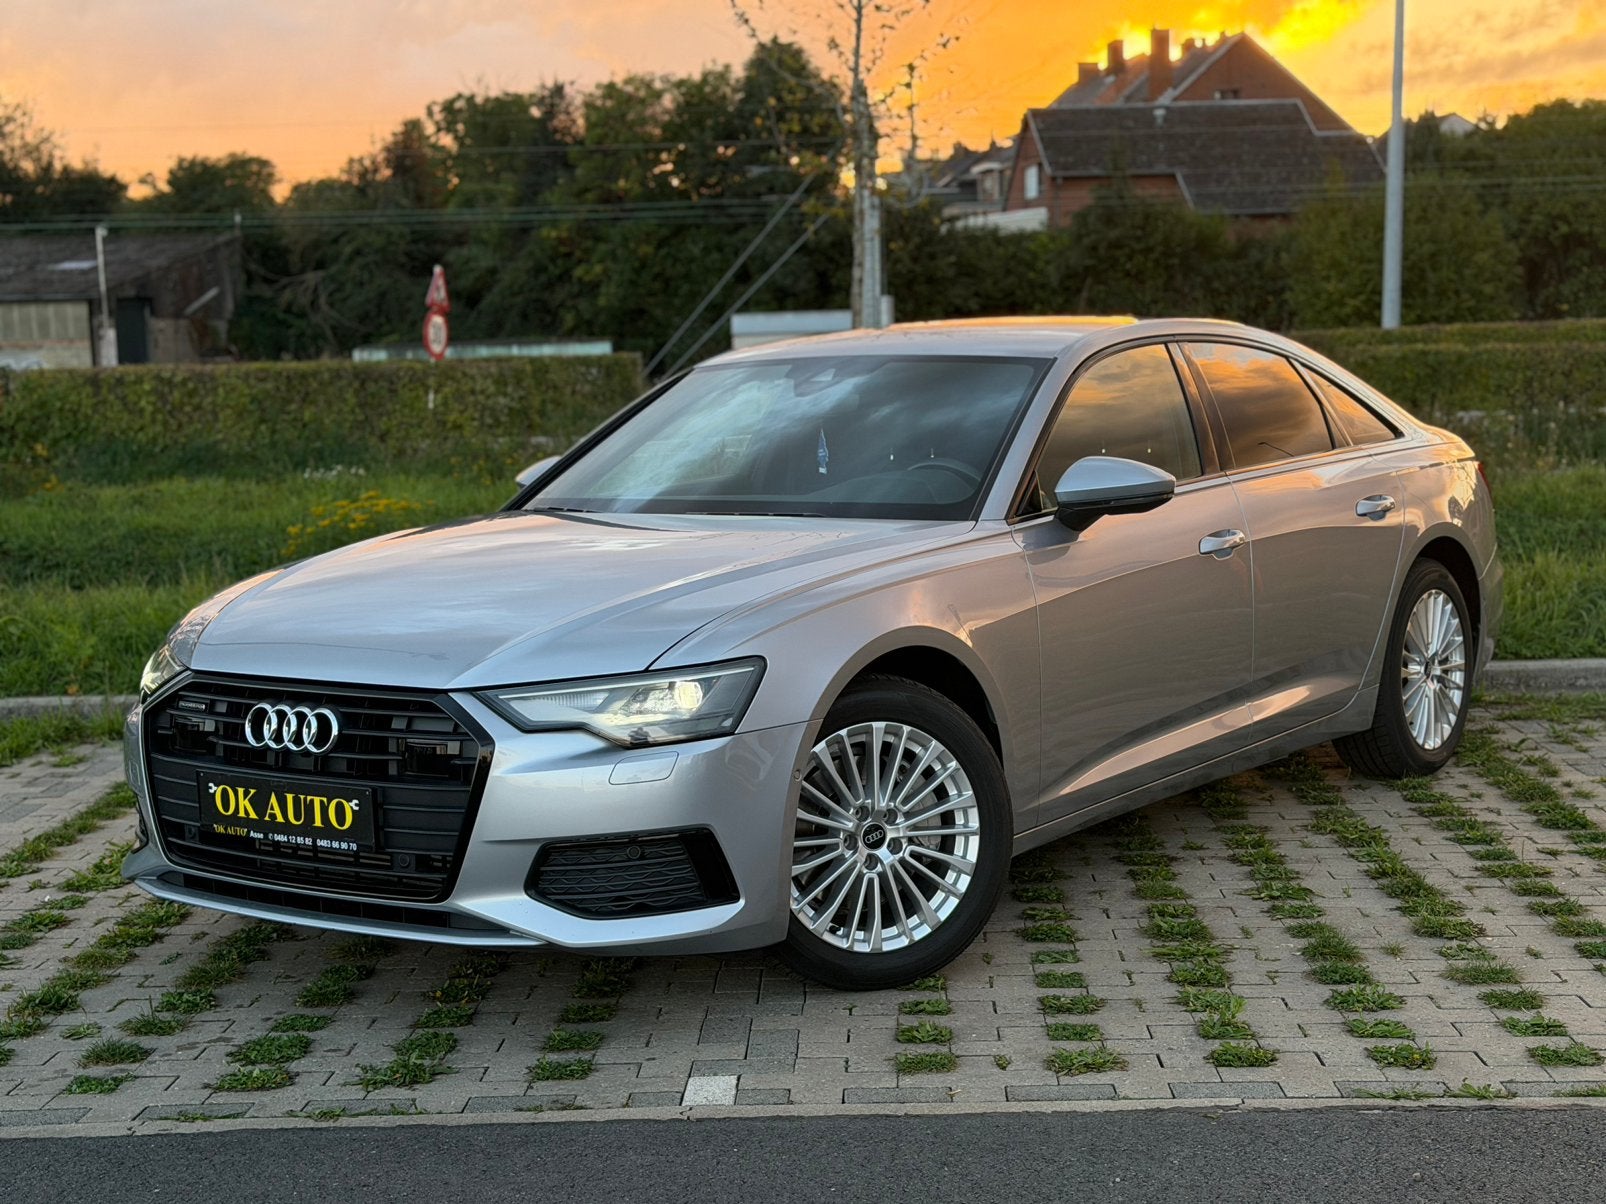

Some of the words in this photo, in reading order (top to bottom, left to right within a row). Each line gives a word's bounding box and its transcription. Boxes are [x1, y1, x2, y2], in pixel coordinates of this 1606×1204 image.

[215, 785, 259, 820] OK
[264, 791, 353, 831] AUTO
[215, 824, 226, 834] OK
[226, 826, 247, 837] AUTO
[250, 830, 264, 839] Asse
[273, 833, 288, 843] 0484
[288, 835, 296, 844] 12
[304, 837, 313, 846] 82
[316, 838, 331, 848] 0483
[340, 841, 349, 850] 90
[349, 842, 358, 851] 70
